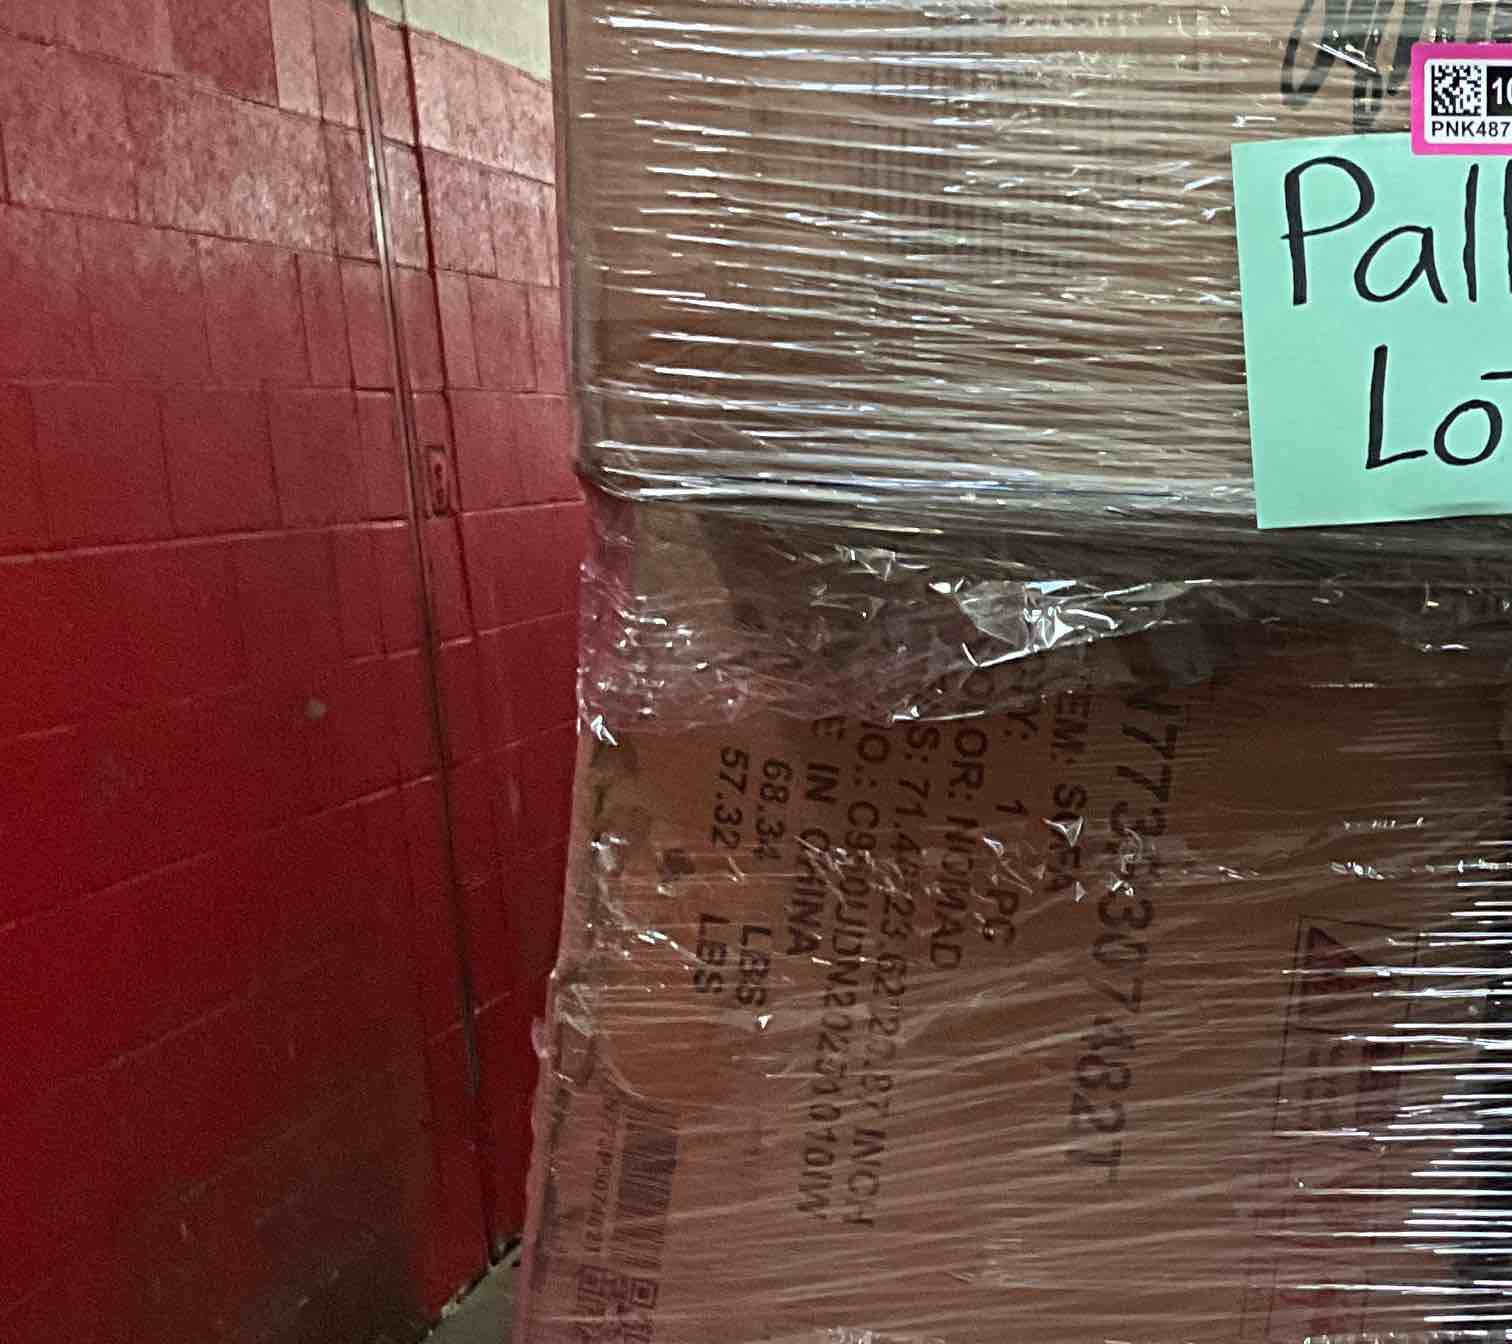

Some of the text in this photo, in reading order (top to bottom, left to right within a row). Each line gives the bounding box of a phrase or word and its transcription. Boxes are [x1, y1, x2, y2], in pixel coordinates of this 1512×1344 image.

[752, 757, 793, 860] 68.34
[804, 762, 840, 805] IN
[692, 745, 750, 995] 57.32 LBS
[784, 828, 831, 956] CHINA
